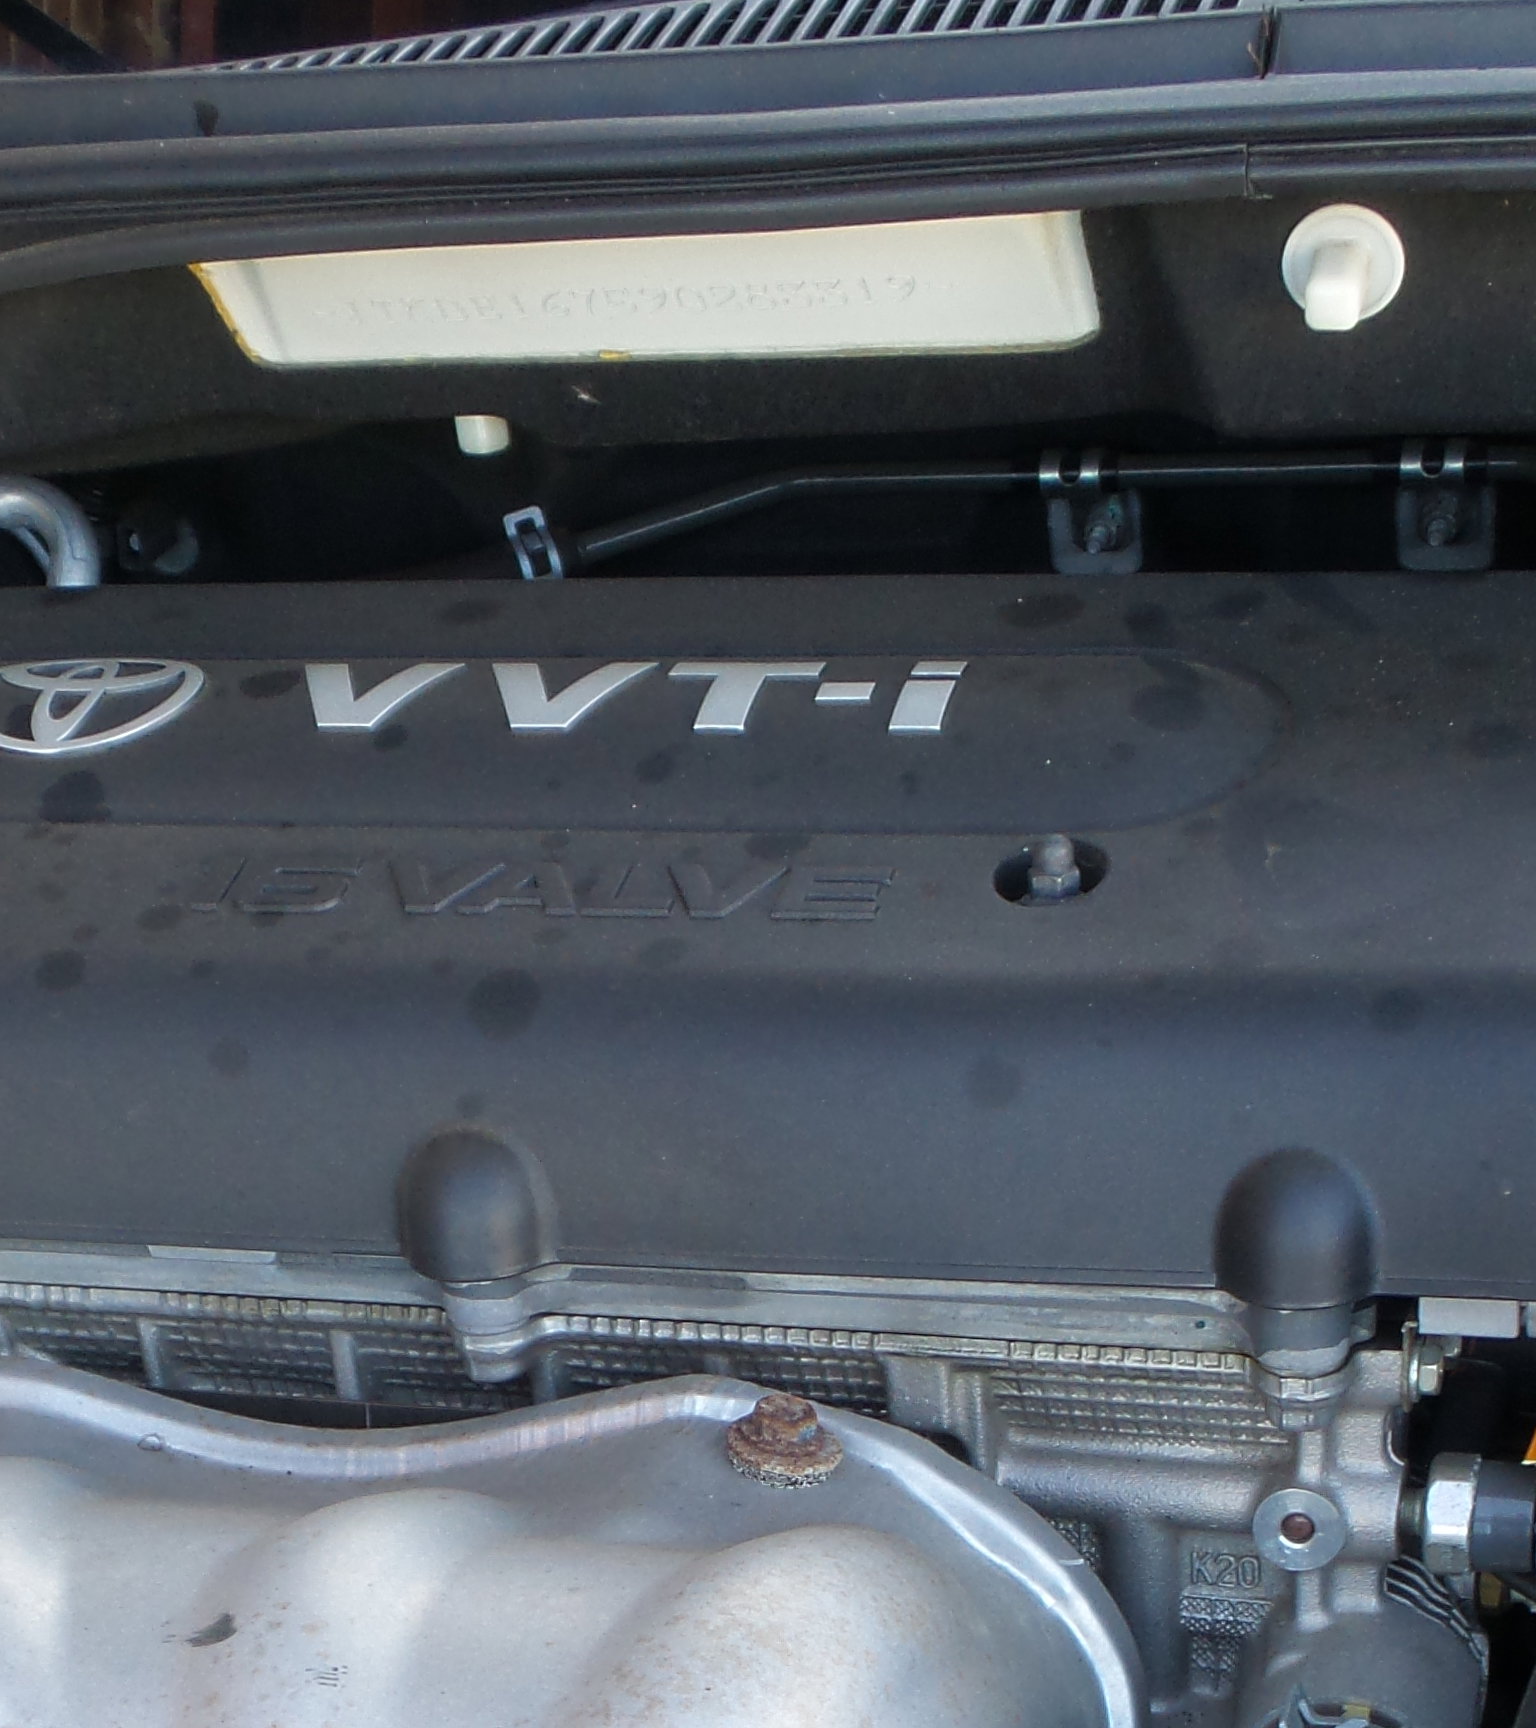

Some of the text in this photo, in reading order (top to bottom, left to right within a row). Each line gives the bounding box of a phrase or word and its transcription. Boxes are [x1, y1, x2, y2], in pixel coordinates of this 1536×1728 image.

[303, 660, 970, 733] VVT-i
[400, 860, 900, 921] VALVE
[1191, 1551, 1262, 1589] K20
